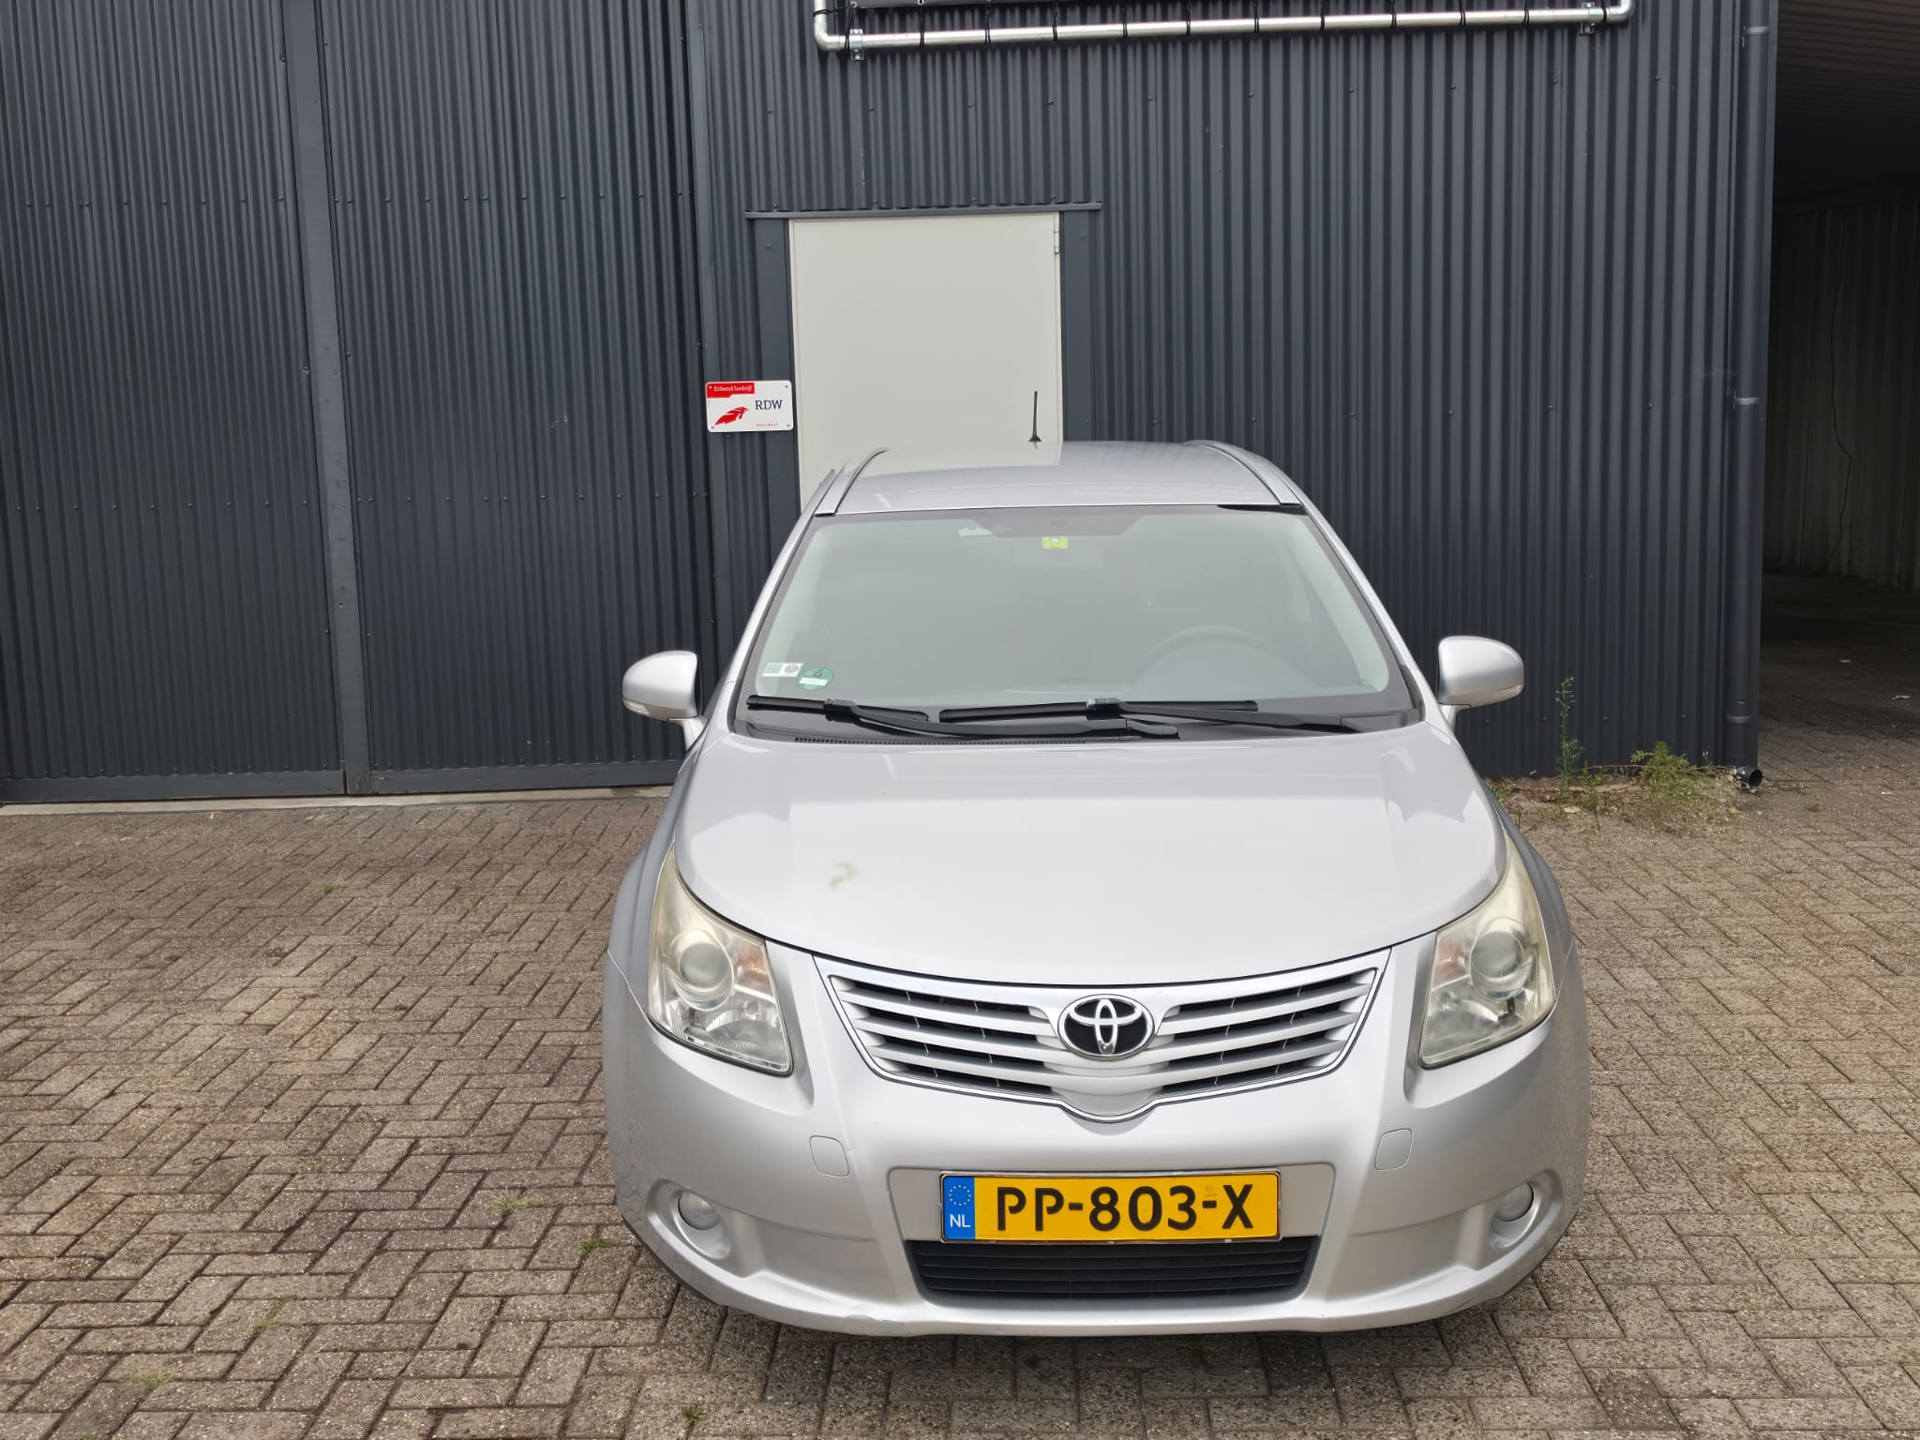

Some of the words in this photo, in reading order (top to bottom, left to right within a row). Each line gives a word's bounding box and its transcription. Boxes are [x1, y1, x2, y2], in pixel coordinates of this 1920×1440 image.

[755, 399, 783, 410] RDW
[949, 1213, 971, 1228] NL
[996, 1183, 1254, 1232] PP-803-X
